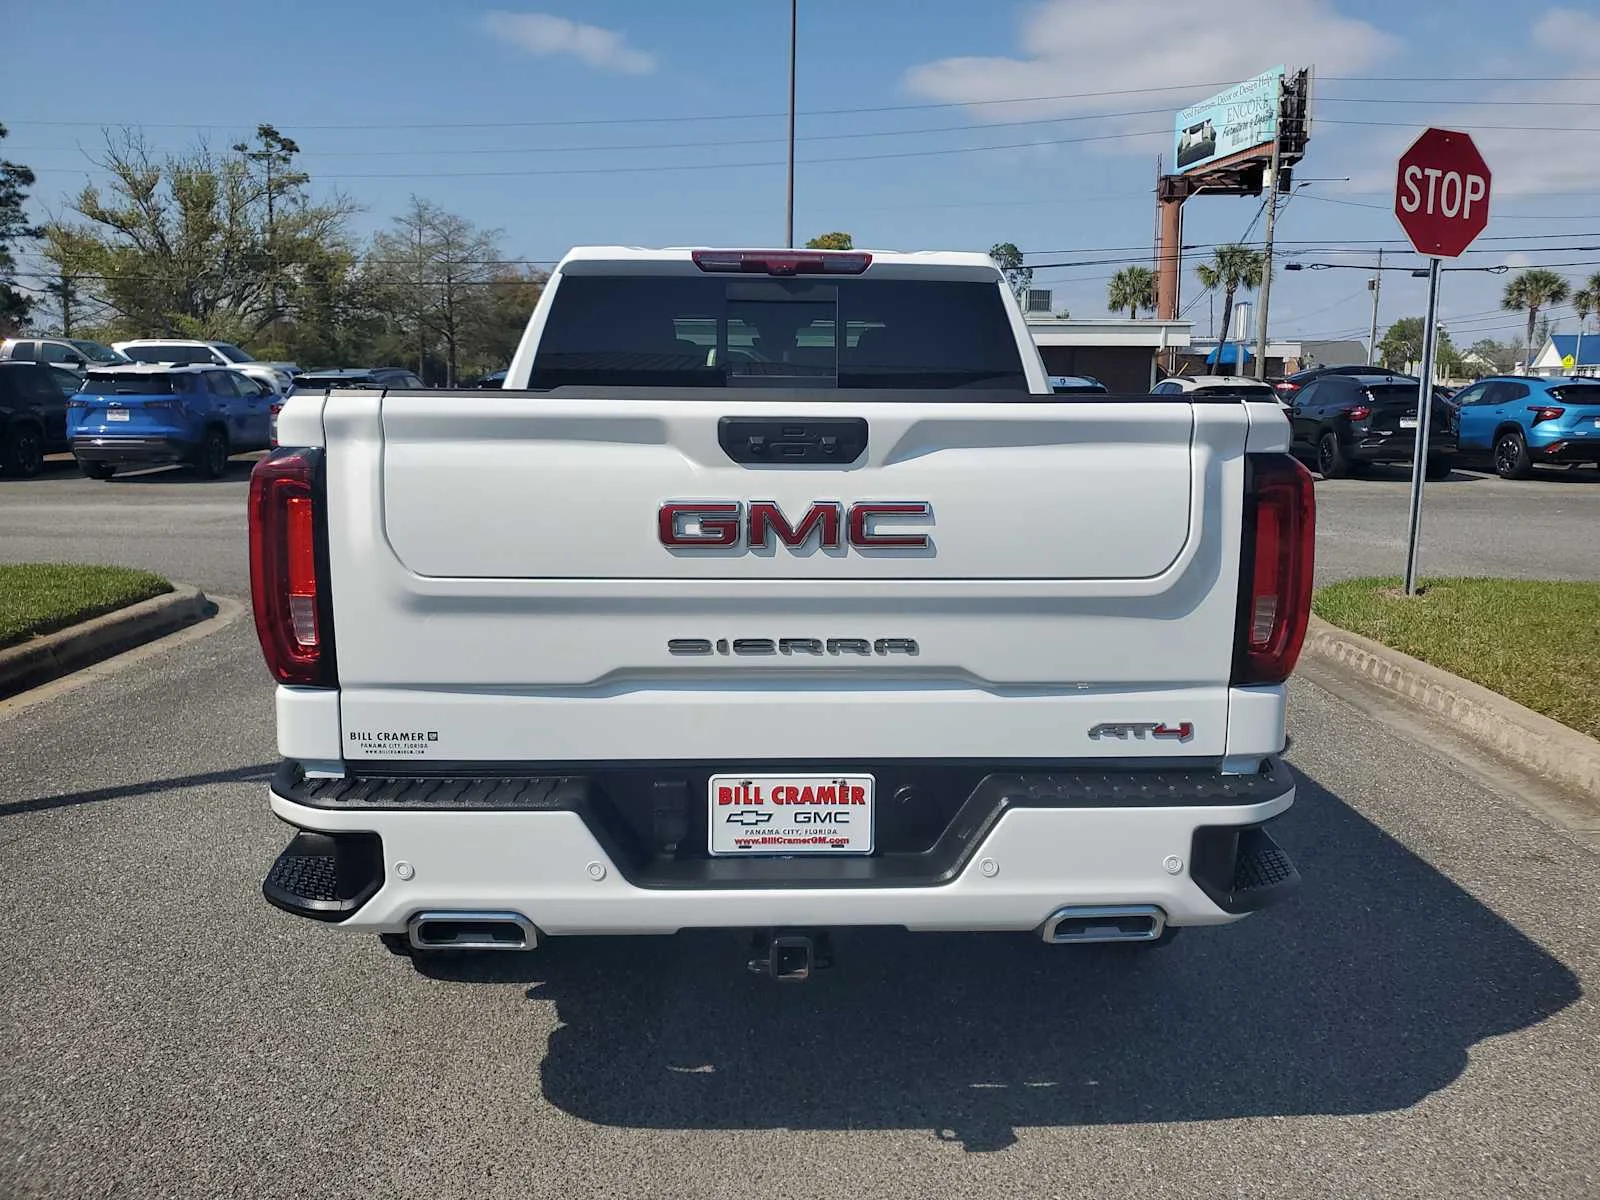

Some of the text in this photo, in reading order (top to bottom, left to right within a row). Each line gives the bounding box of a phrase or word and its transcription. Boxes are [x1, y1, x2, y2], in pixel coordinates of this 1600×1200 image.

[1226, 93, 1269, 123] ENCORE
[1401, 165, 1485, 219] STOP
[658, 500, 930, 549] GMC
[667, 638, 920, 655] SIERRA
[350, 732, 373, 741] BILL
[377, 732, 424, 741] CRAMER
[1088, 722, 1194, 742] AT4
[718, 786, 865, 805] BILL CRAMER
[794, 812, 849, 823] GMC
[735, 837, 849, 845] www.BillCramerGM.com
